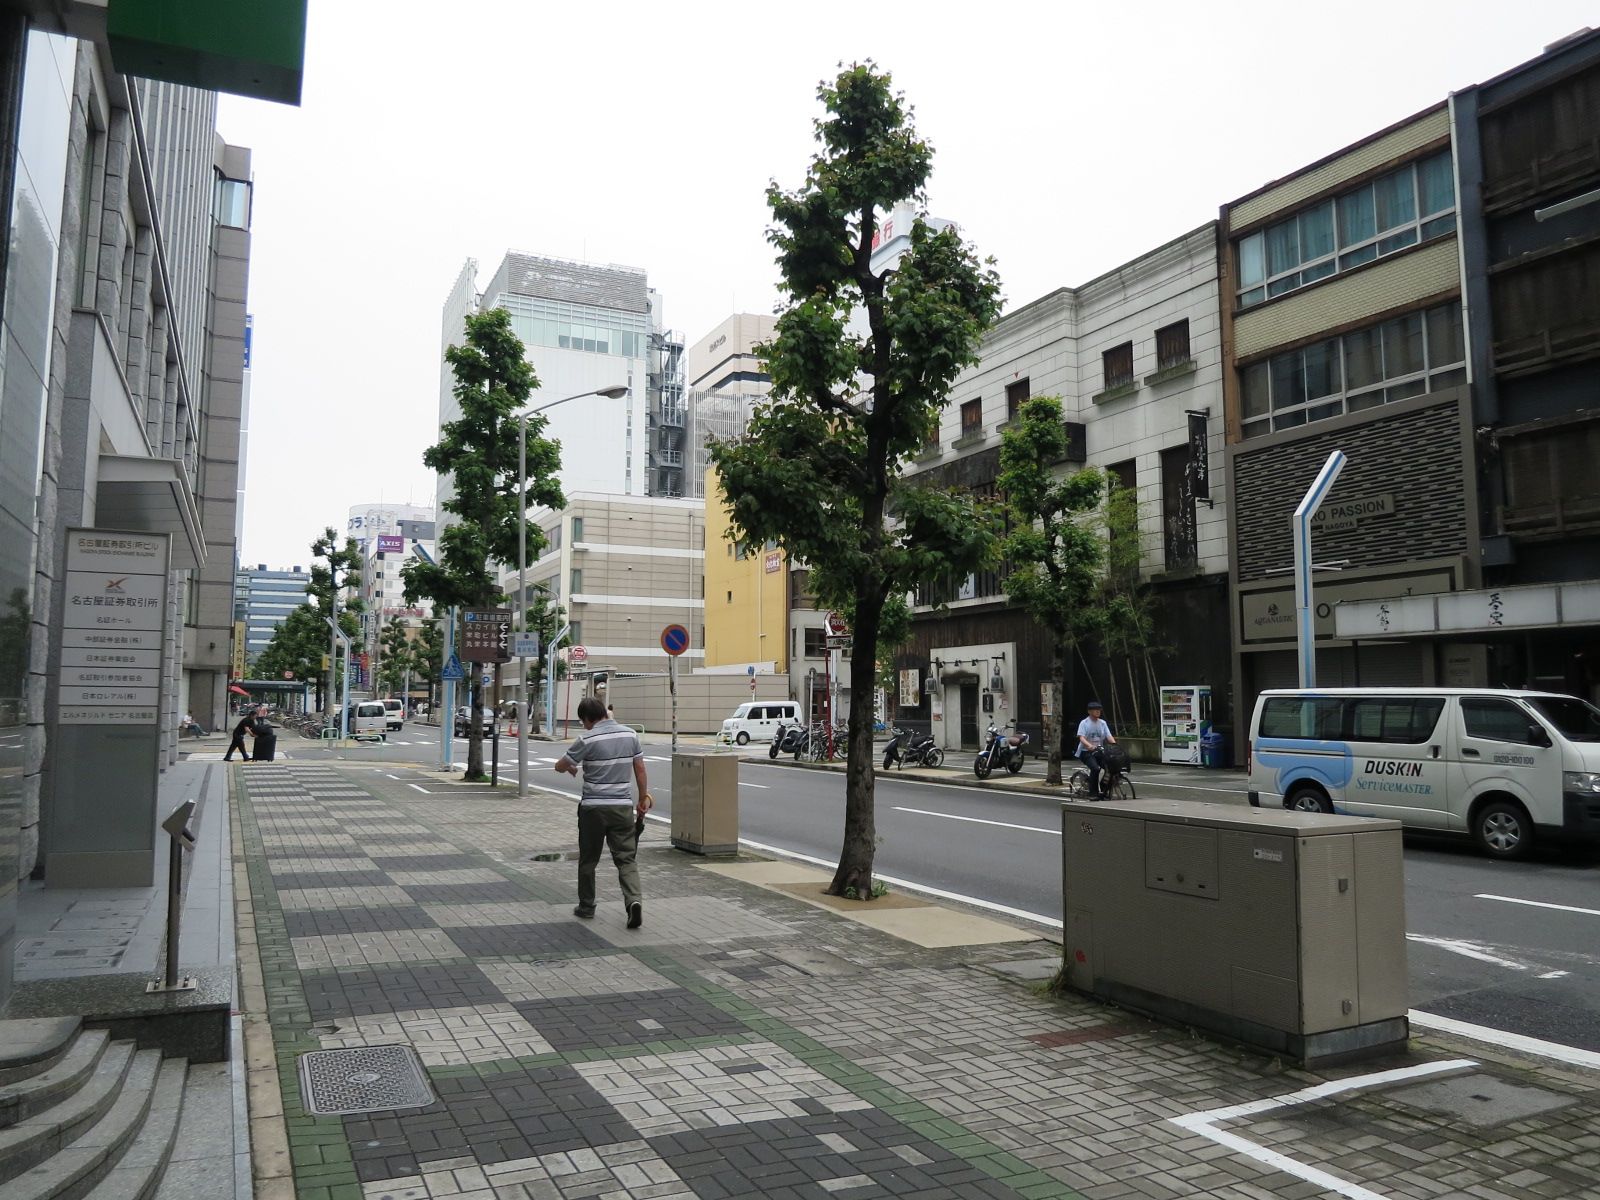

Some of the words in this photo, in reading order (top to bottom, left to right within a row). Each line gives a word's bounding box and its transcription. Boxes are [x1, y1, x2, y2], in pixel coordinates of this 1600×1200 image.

[1331, 499, 1385, 518] PASSION
[1325, 521, 1353, 530] NAGOYA
[78, 538, 159, 550] 名古屋証券取引所ビル
[71, 595, 158, 608] 名古屋証券取引所
[97, 616, 132, 624] 名証ホール
